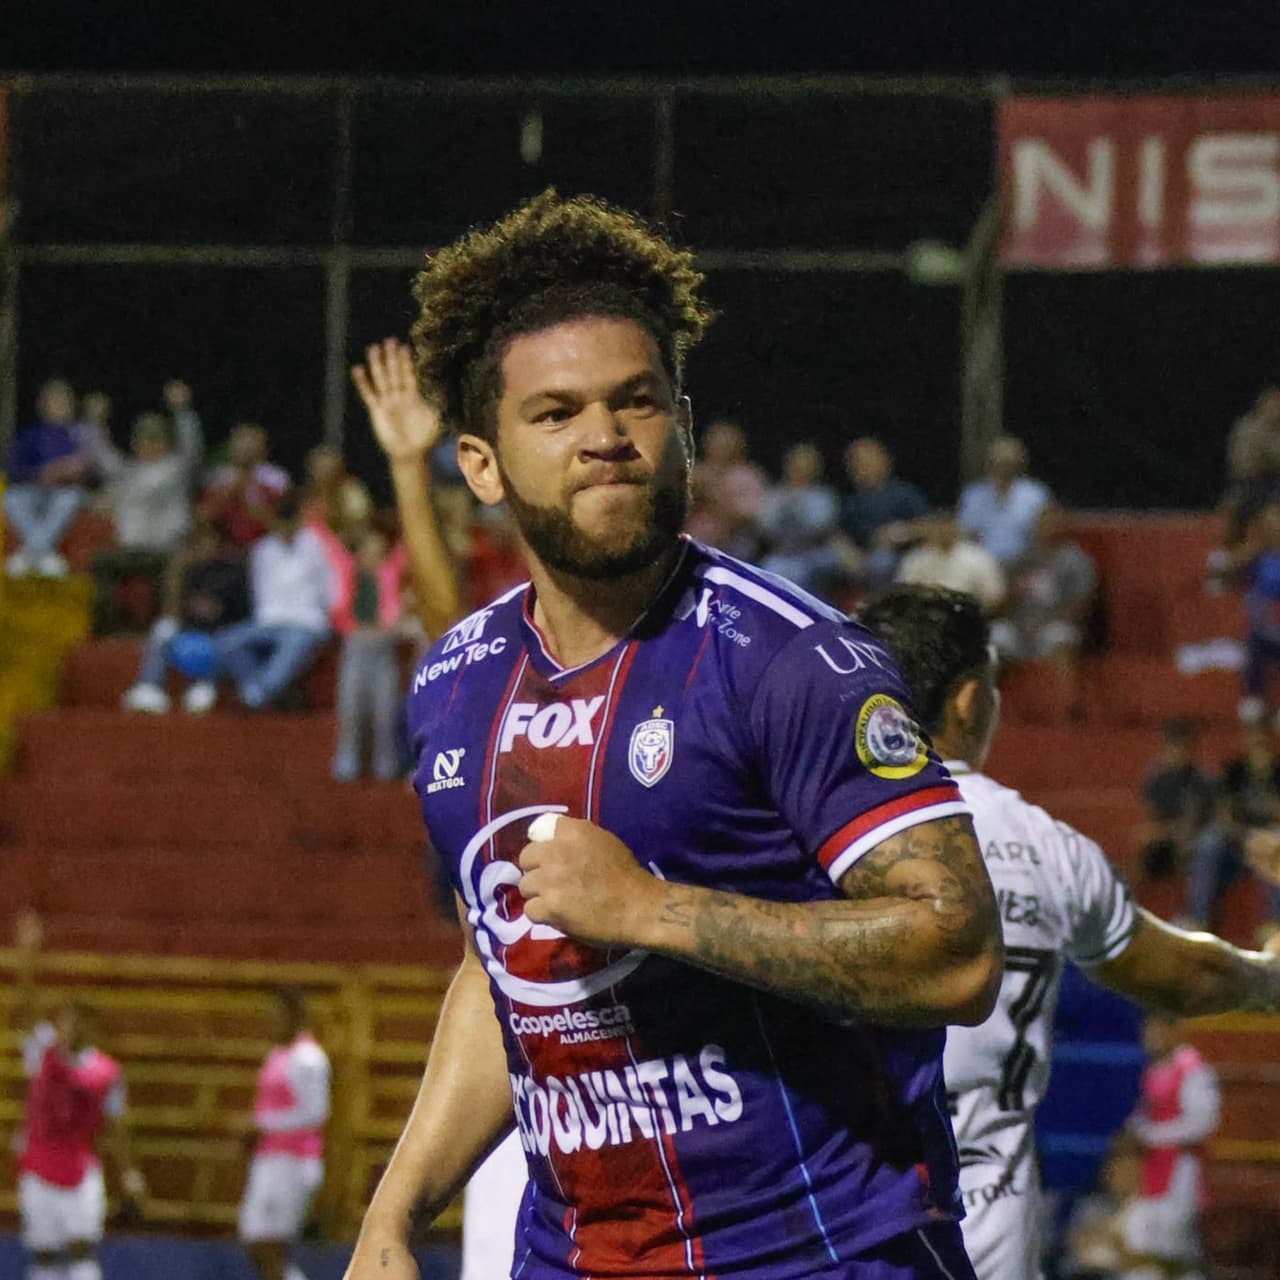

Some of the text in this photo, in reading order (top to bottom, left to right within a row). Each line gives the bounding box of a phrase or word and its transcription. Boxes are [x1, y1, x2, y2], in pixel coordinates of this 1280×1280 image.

[414, 636, 507, 694] NewTec
[499, 695, 606, 753] FOX
[509, 1004, 632, 1038] Coopelesca
